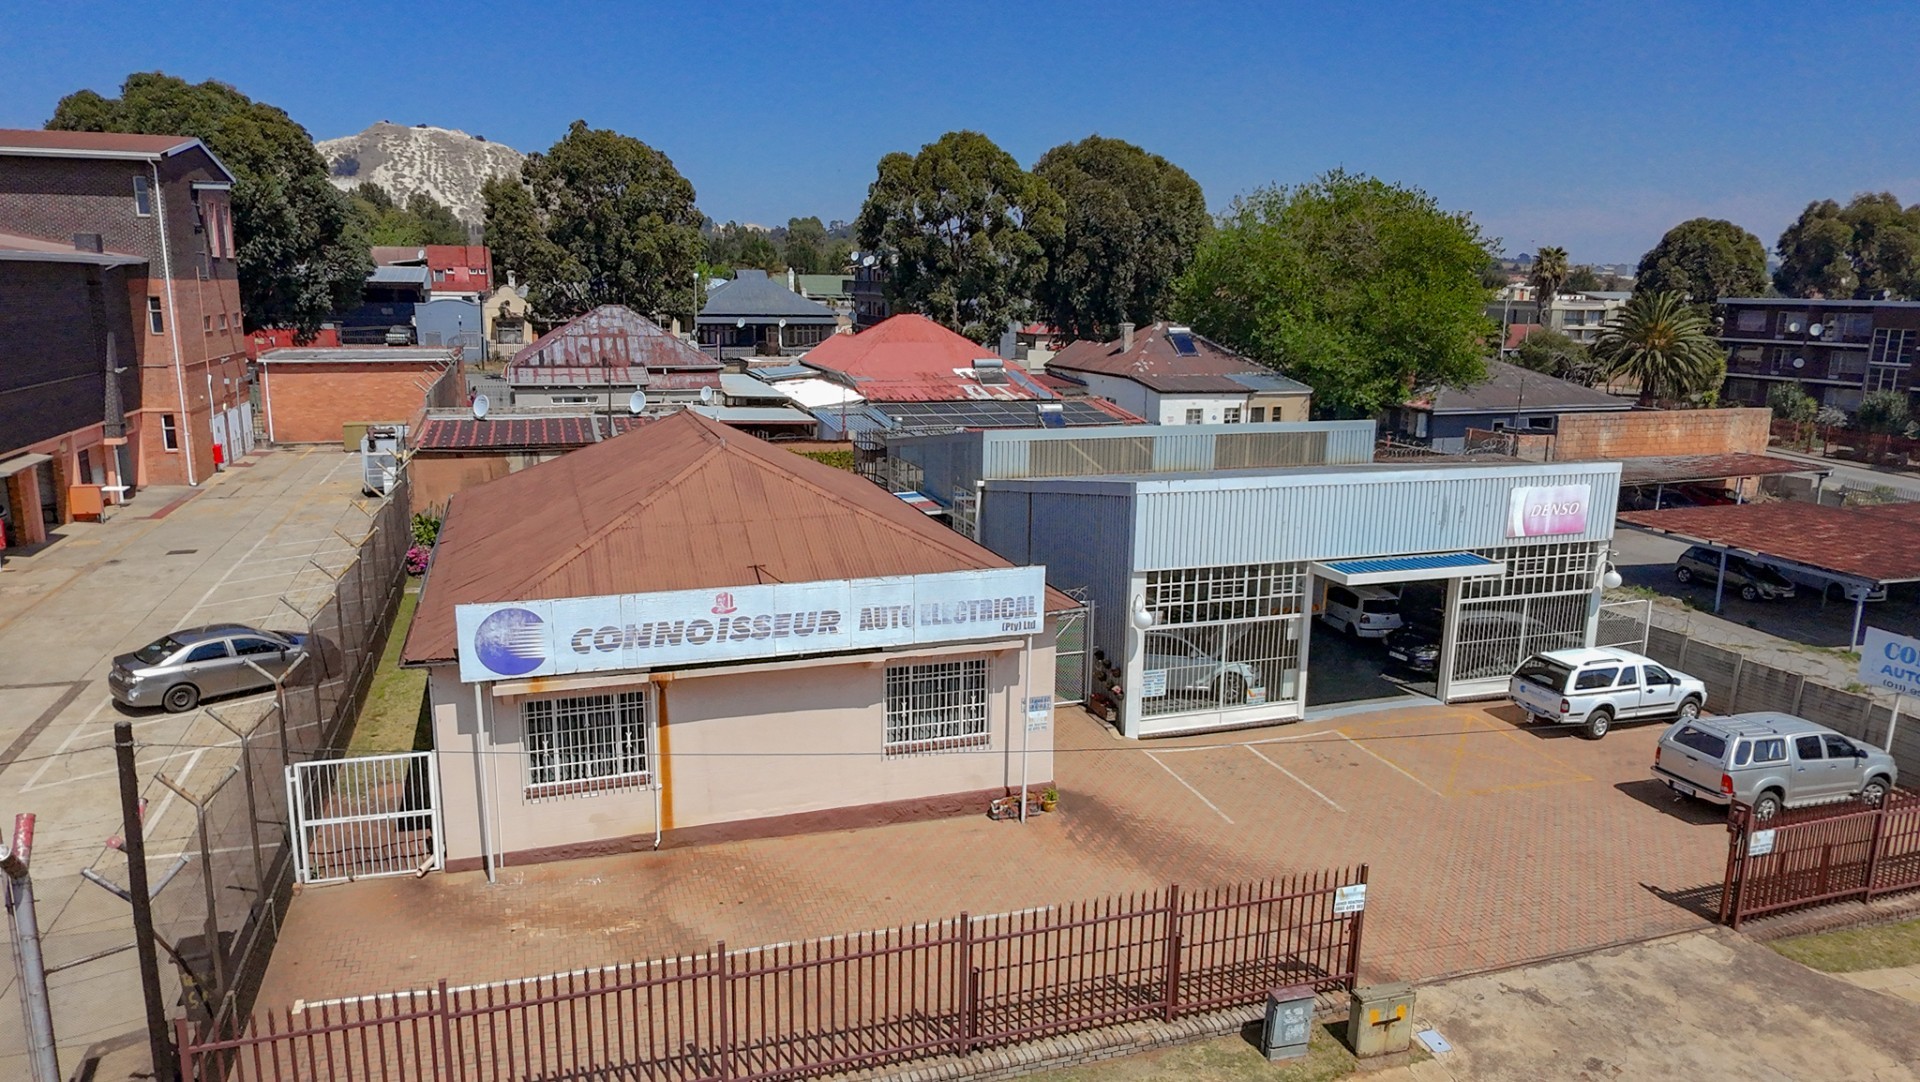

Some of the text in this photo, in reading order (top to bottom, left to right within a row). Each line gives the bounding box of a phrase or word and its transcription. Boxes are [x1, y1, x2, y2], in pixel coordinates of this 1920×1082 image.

[1530, 502, 1580, 517] DENSO
[571, 610, 841, 654] CONNOISSEUR
[859, 604, 914, 631] AUTO
[1002, 620, 1036, 632] (Pty) Ltd
[1884, 642, 1920, 667] CO
